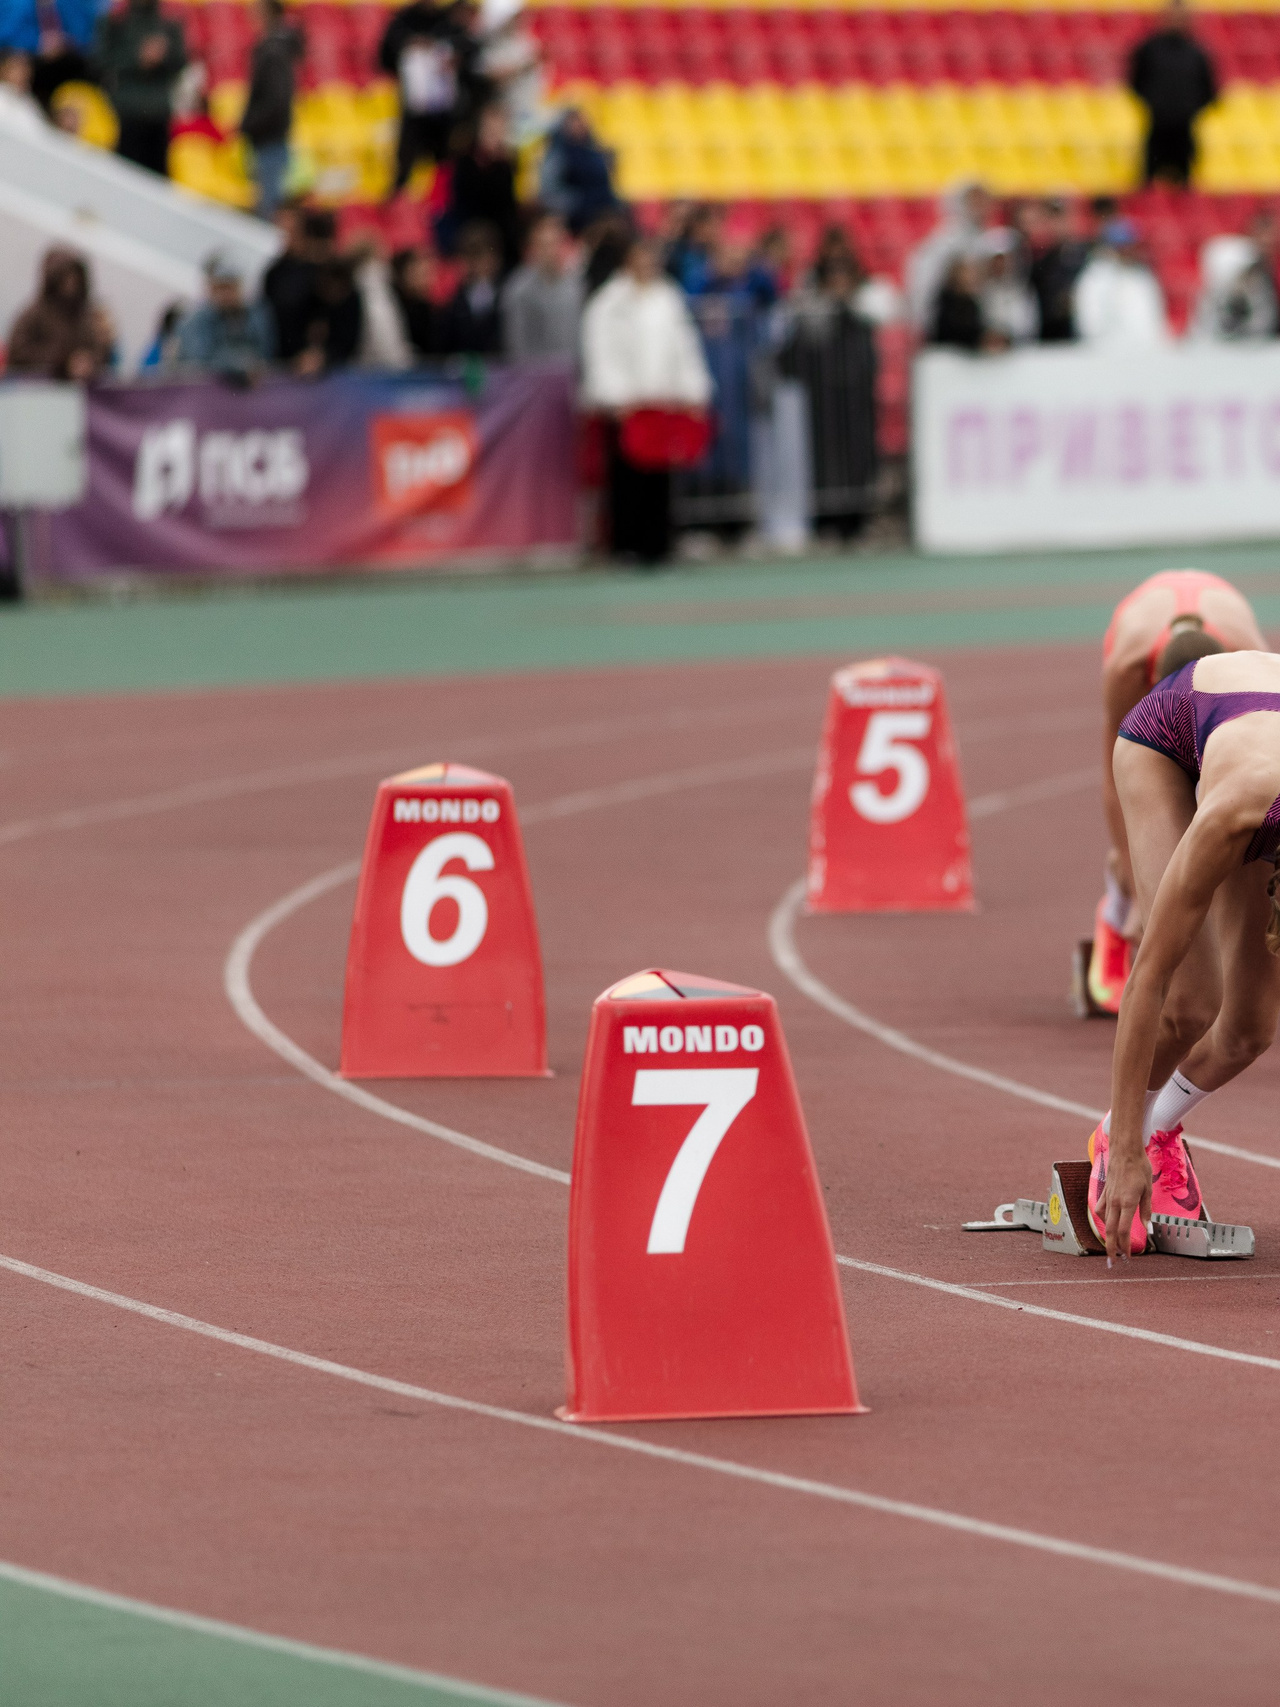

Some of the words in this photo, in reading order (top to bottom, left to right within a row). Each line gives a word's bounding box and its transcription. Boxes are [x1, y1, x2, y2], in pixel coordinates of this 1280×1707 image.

[394, 799, 500, 823] MONDO
[850, 711, 931, 823] 5
[400, 832, 494, 967] 6
[623, 1024, 765, 1054] MONDO
[631, 1067, 759, 1255] 7
